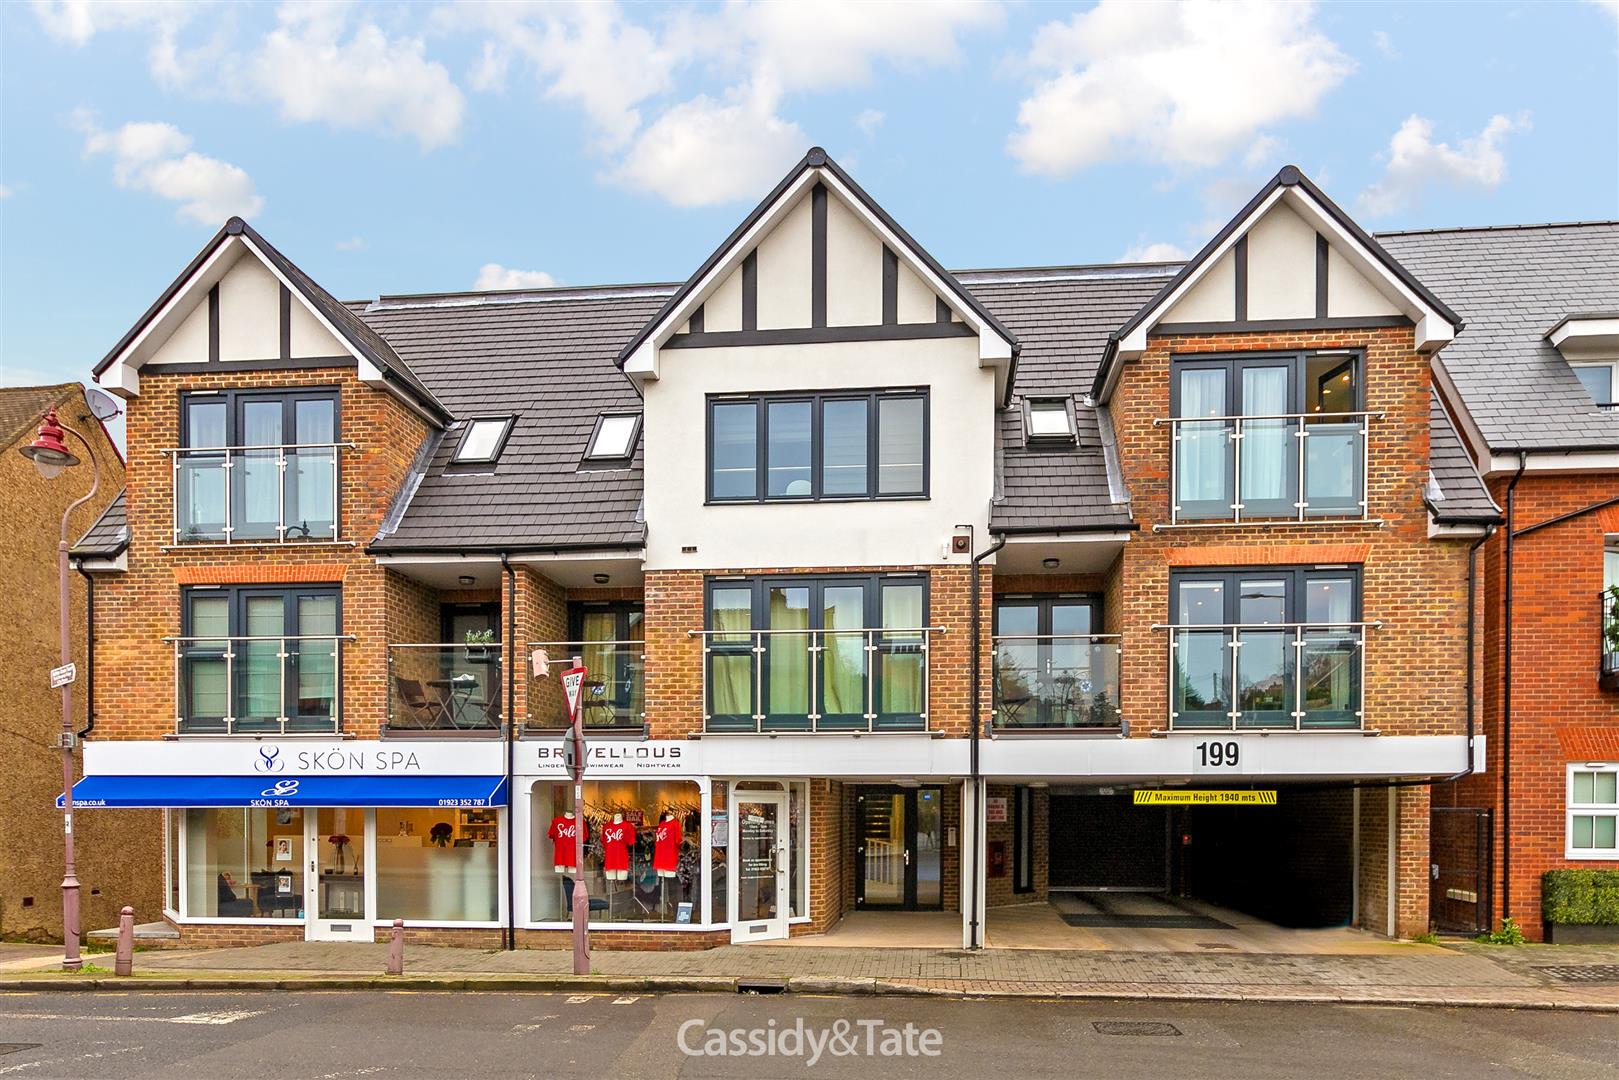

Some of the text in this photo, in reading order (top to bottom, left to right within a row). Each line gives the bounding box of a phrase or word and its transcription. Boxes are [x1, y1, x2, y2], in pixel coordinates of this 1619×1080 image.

[566, 675, 579, 687] GIVE
[298, 748, 420, 770] SKÖN SPA
[538, 747, 681, 758] BRELLOUS
[1196, 741, 1239, 766] 199
[61, 799, 106, 807] snspa.co.uk
[1155, 793, 1191, 801] Maximum
[1193, 793, 1217, 803] Height
[1220, 793, 1239, 801] 1940
[557, 823, 576, 838] Sale
[604, 828, 623, 843] Sale
